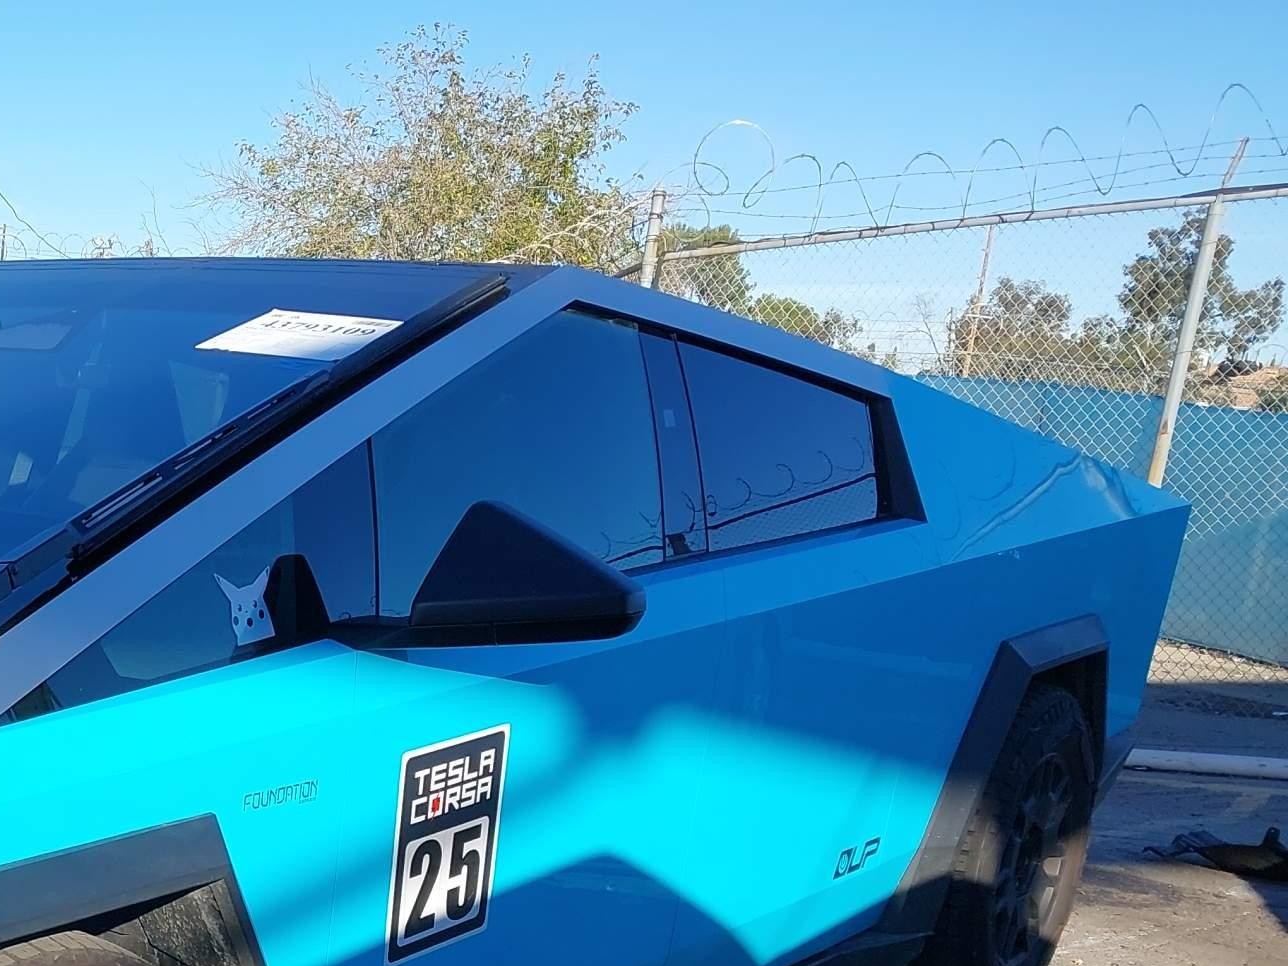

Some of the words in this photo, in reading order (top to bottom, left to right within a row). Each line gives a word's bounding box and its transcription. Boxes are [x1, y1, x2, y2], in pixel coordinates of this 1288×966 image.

[243, 779, 319, 812] FOUNDATION
[414, 748, 496, 796] TESLA
[410, 776, 493, 825] CORSA
[404, 823, 482, 939] 25
